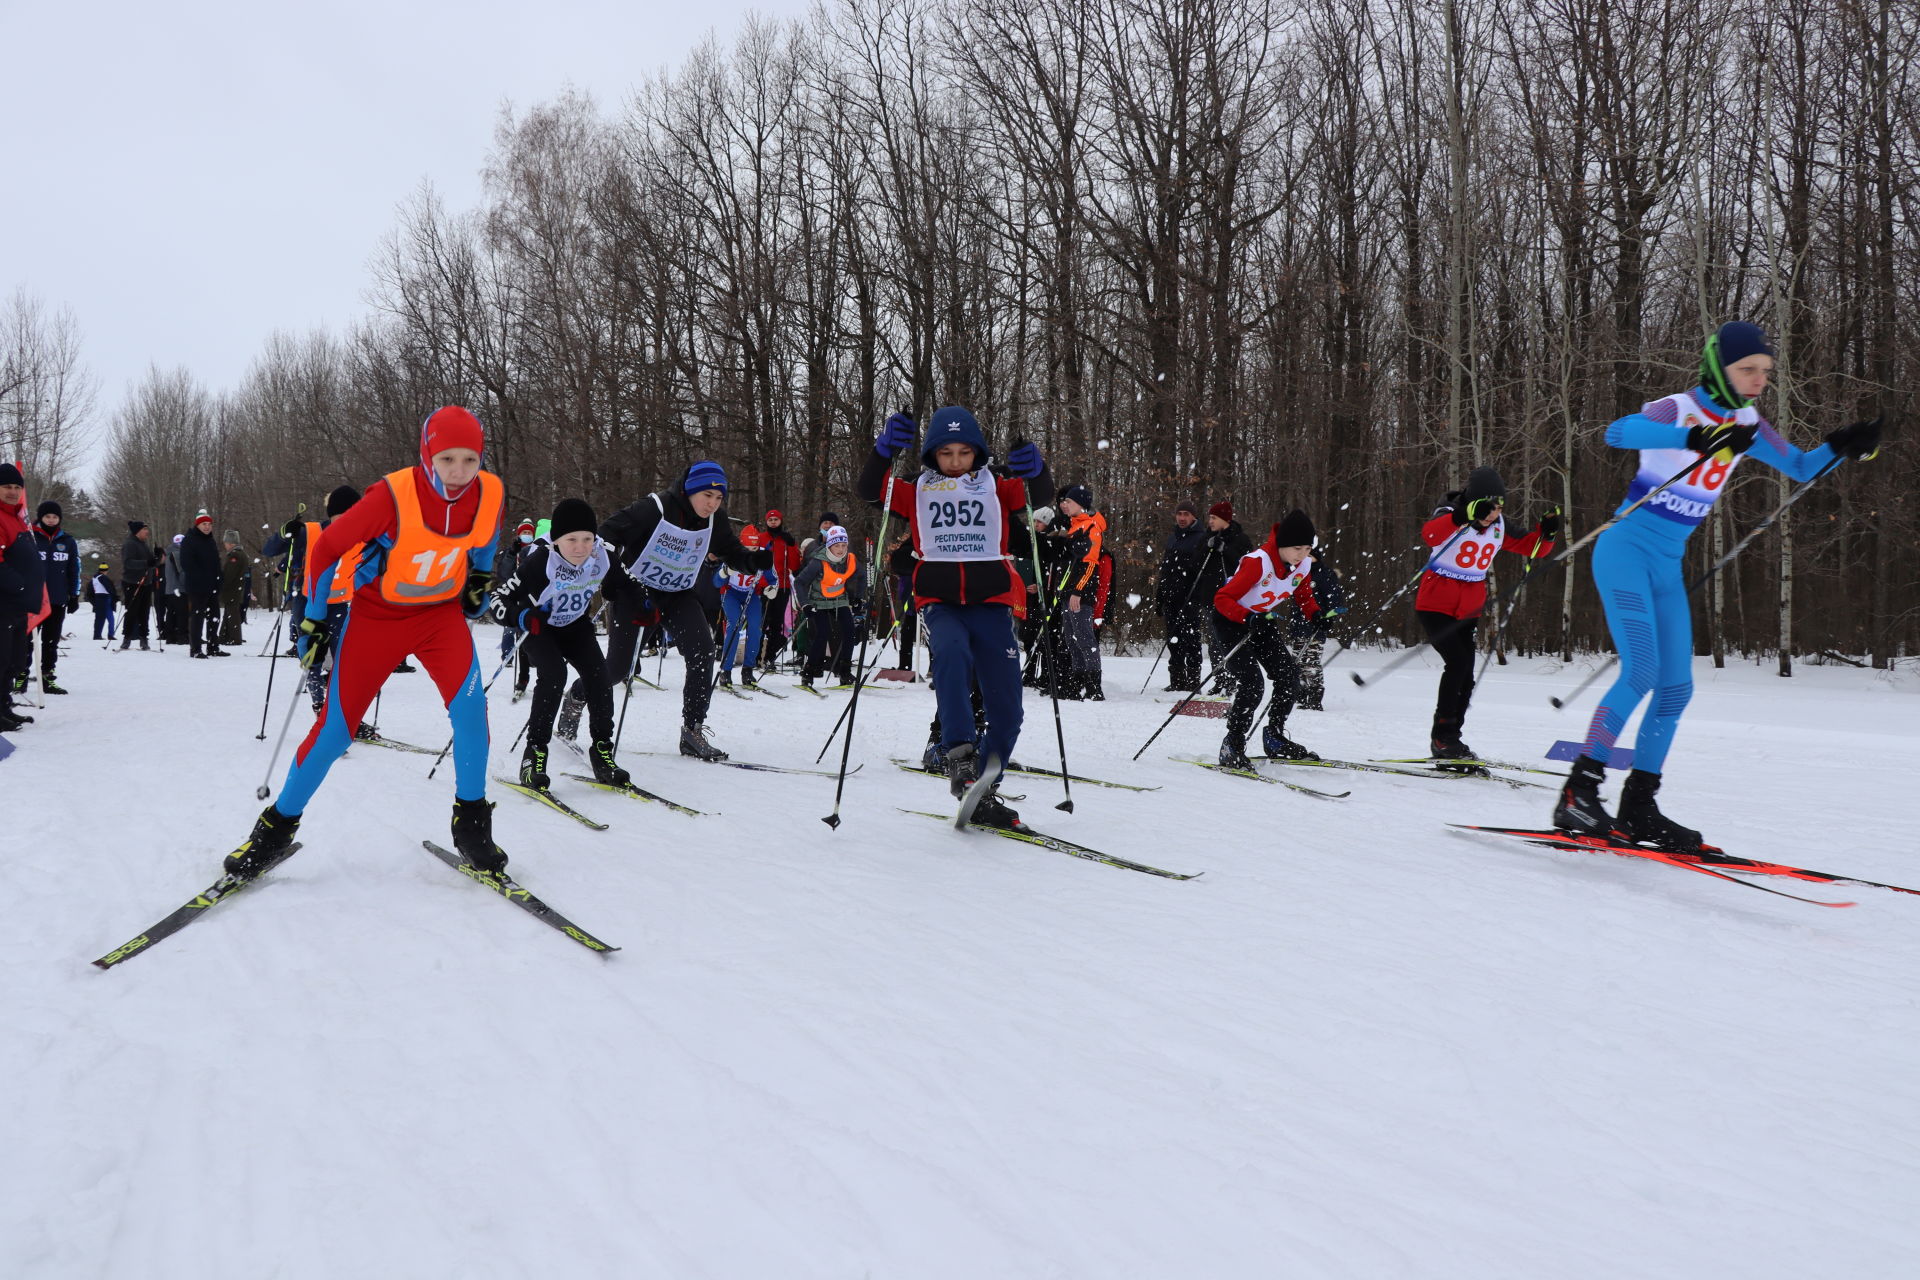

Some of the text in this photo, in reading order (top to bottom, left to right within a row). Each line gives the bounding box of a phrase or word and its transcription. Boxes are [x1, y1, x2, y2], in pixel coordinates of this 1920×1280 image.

[1685, 448, 1731, 491] 18
[928, 500, 986, 528] 2952
[657, 538, 685, 553] РОССИИ
[660, 532, 688, 547] ЛЫЖНЯ
[934, 533, 986, 543] РЕСПУБЛИКА
[937, 543, 984, 553] ТАТАРСТАН
[411, 547, 460, 583] 11
[653, 545, 682, 561] 2022
[1455, 541, 1495, 570] 88
[641, 561, 693, 590] 12645
[458, 865, 501, 894] FISCHER
[560, 926, 606, 950] FISCHER
